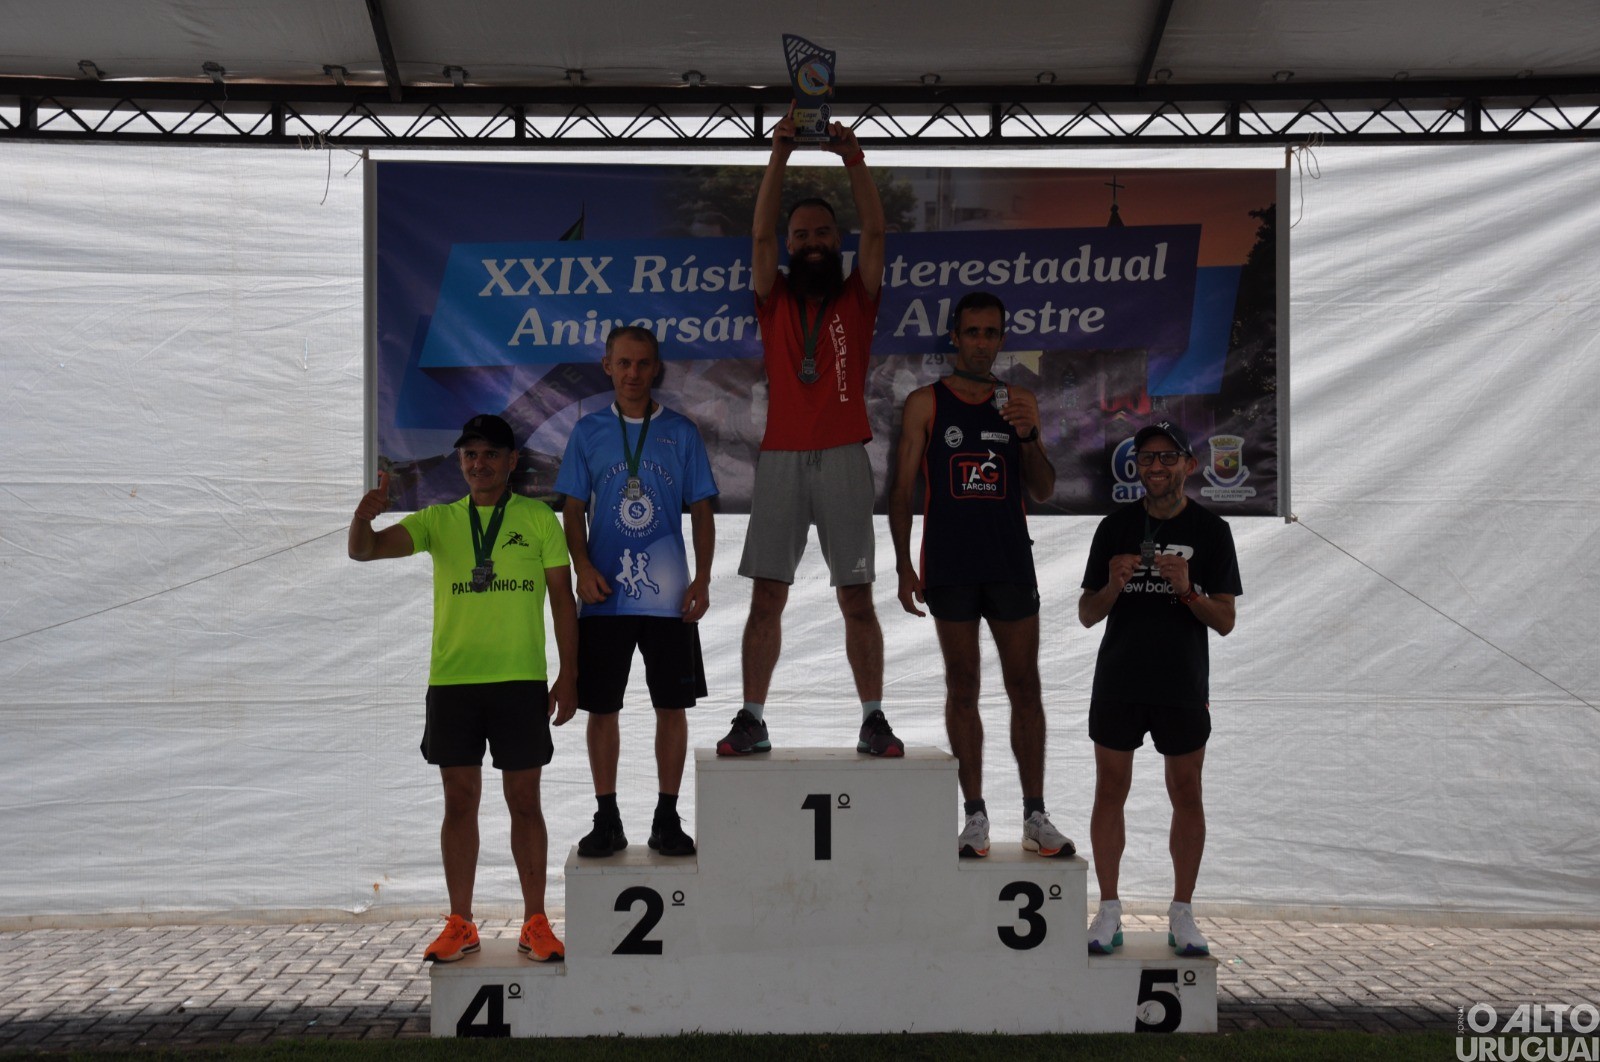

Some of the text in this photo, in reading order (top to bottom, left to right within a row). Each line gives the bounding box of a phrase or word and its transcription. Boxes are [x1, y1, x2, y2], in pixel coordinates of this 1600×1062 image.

[478, 242, 1168, 297] XXIX Rúst Iterestadual
[507, 303, 762, 346] Anivrsár
[893, 298, 1105, 345] Alstre
[956, 460, 1000, 484] TAG
[962, 483, 997, 491] TARCISO
[1113, 484, 1147, 501] an
[452, 579, 534, 595] PALINHO-RS
[801, 793, 851, 860] 1º
[612, 881, 1062, 955] 2º 3º
[456, 969, 1196, 1037] 4º 5º
